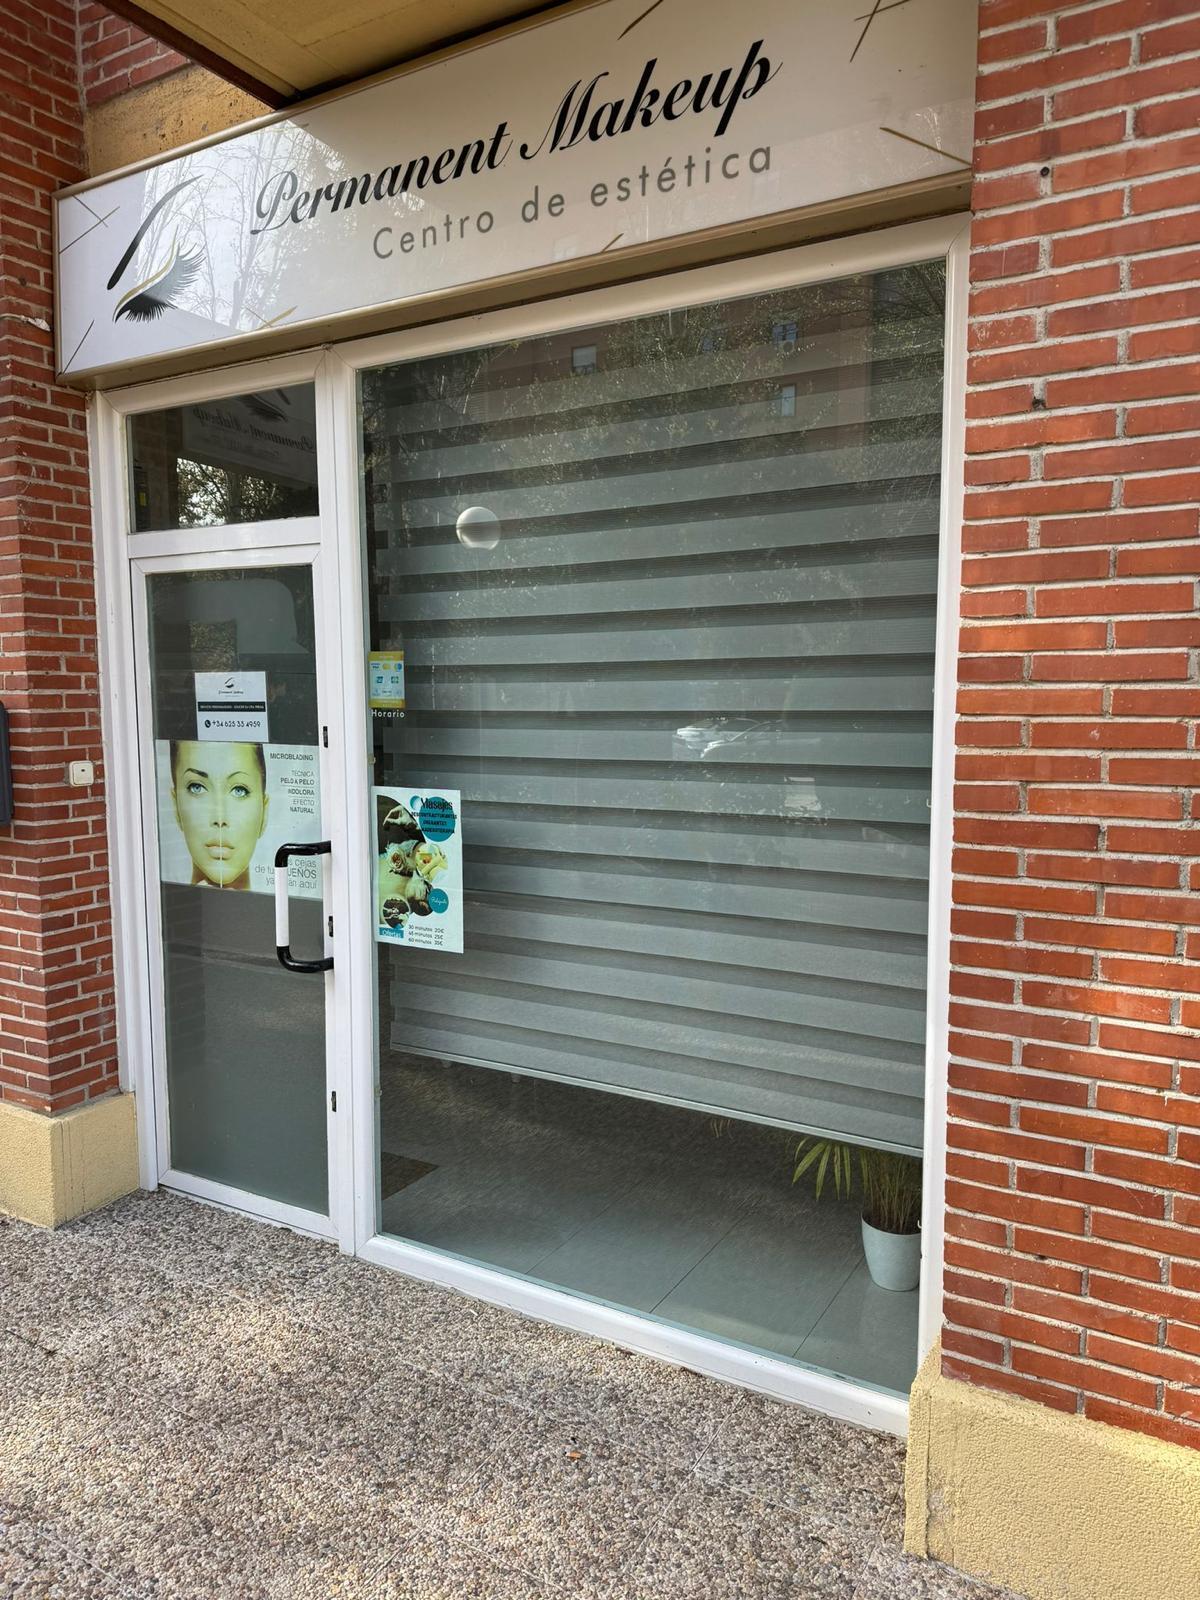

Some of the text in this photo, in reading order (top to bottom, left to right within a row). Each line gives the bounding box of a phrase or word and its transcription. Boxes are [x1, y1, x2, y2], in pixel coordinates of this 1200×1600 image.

[251, 39, 783, 235] Permanent Makeup
[372, 144, 772, 259] Centro de estética
[371, 709, 405, 718] Horario
[212, 720, 223, 728] +34
[225, 720, 236, 728] 625
[246, 720, 261, 728] 4959
[270, 752, 314, 761] MICROBLADING
[292, 799, 315, 807] EFECTO
[289, 806, 315, 814] NATURAL
[295, 859, 316, 869] cejas
[255, 864, 266, 874] de
[300, 880, 317, 889] aquí
